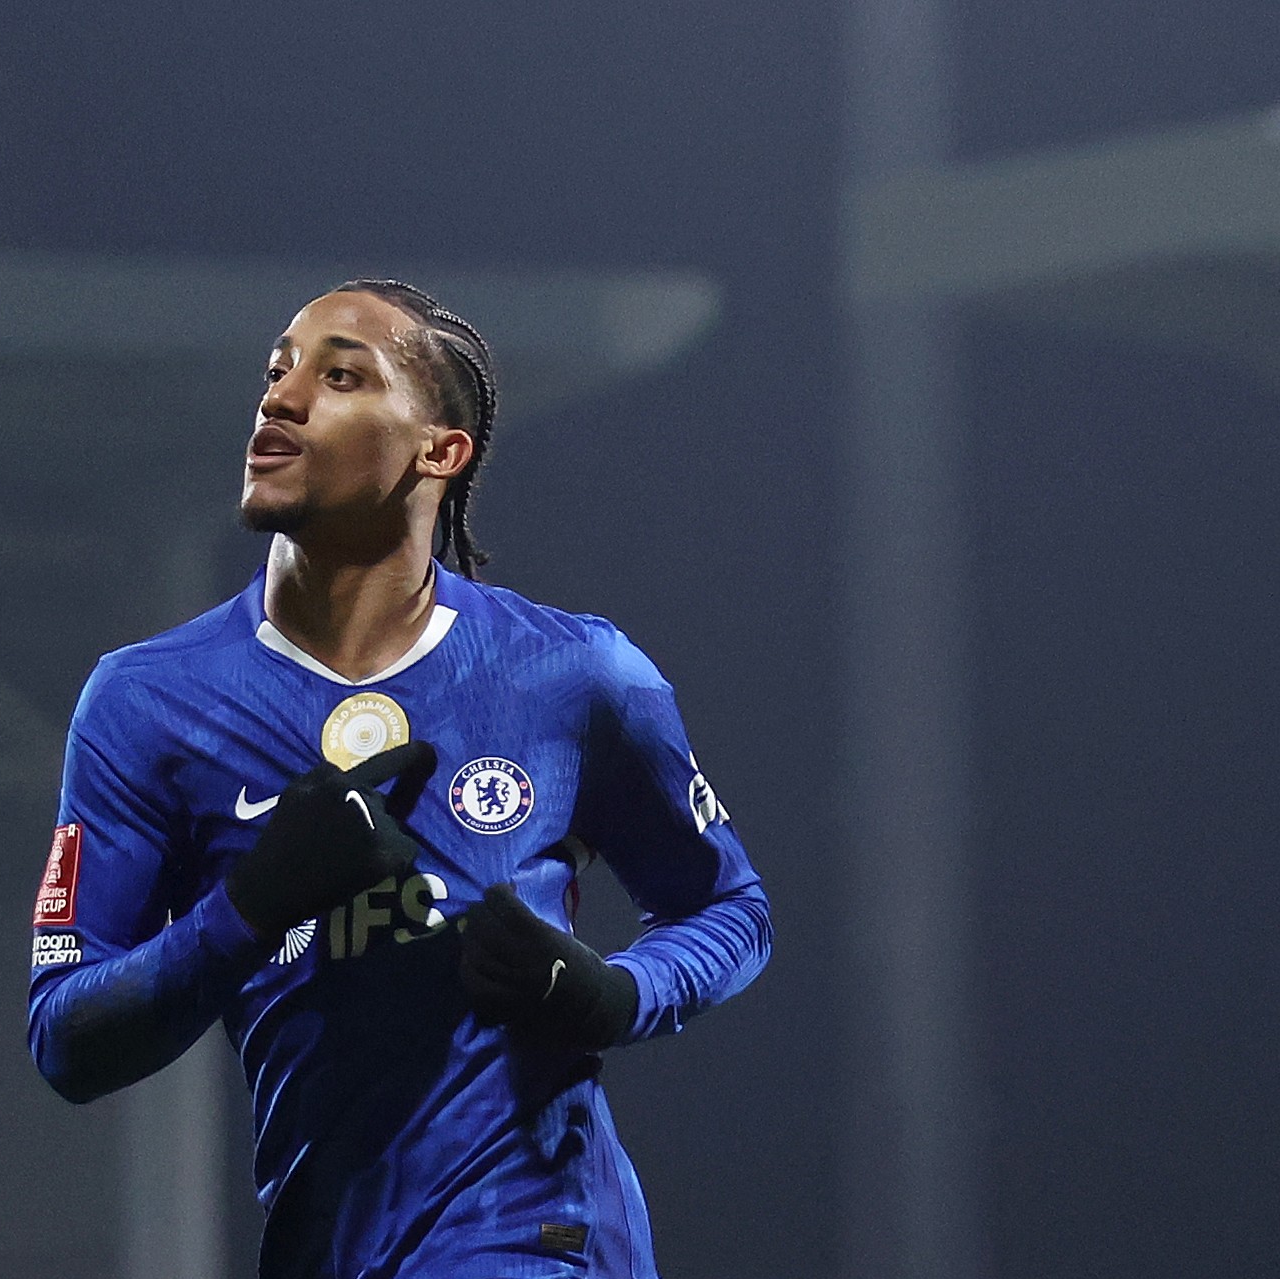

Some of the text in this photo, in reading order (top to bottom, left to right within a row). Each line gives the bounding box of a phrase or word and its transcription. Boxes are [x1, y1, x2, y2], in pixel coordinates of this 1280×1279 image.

[350, 700, 402, 741] CHAMPIONS
[461, 760, 515, 779] CHELSEA
[465, 812, 522, 830] FOOTBALL CLUB
[37, 887, 67, 899] rates
[43, 898, 67, 912] CUP
[32, 948, 82, 968] racism
